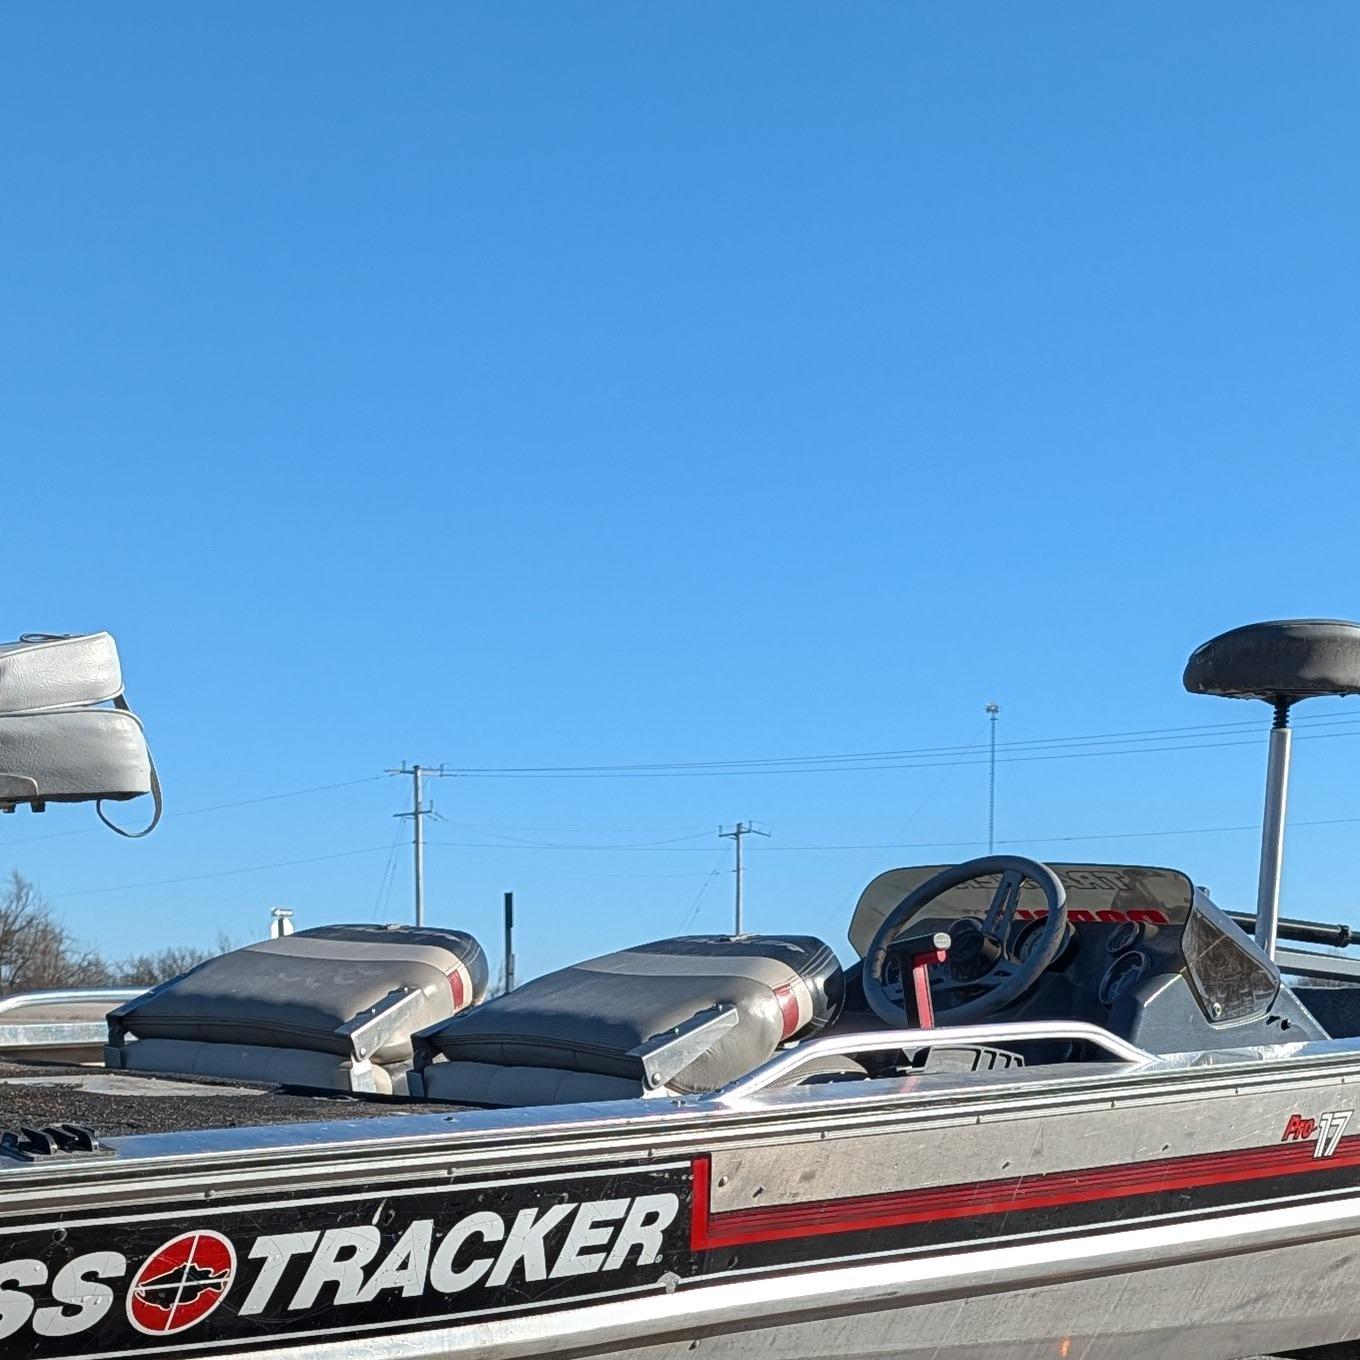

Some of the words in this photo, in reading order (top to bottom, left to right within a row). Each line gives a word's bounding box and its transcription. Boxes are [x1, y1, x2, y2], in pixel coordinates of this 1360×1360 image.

[1281, 1114, 1317, 1142] Pro
[1313, 1109, 1355, 1160] 17
[237, 1192, 680, 1317] TRACKER
